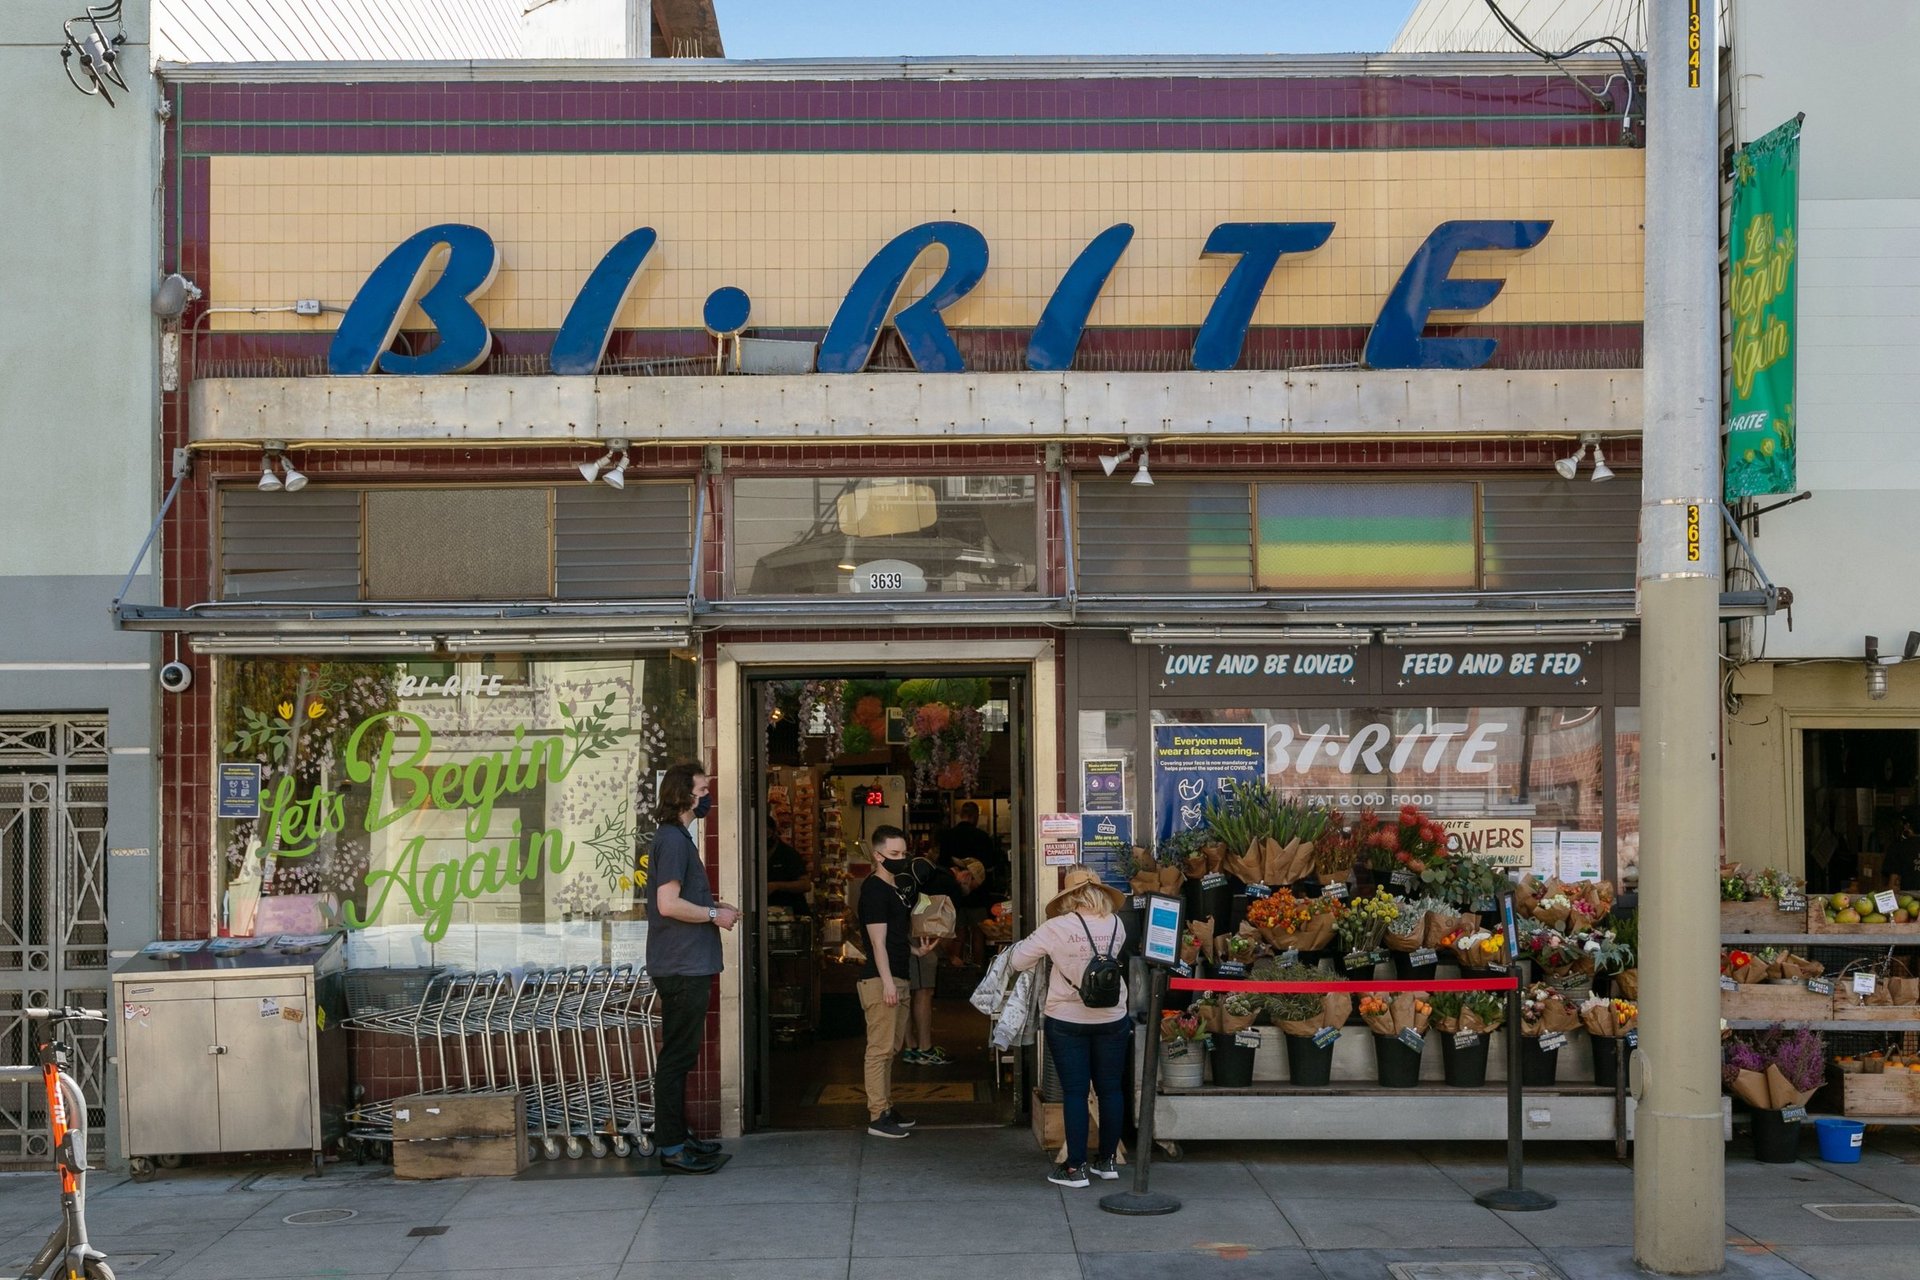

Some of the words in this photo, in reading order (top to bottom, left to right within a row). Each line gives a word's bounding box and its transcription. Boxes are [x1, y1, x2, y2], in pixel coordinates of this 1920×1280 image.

[1688, 506, 1699, 561] 365
[871, 573, 901, 589] 3639
[1165, 654, 1213, 675] LOVE
[1216, 654, 1259, 675] AND
[1263, 654, 1290, 675] BE
[1293, 654, 1354, 675] LOVED
[1402, 653, 1453, 675] FEED
[1458, 653, 1504, 675] AND
[1508, 653, 1537, 675] BE
[1540, 653, 1581, 675] FED
[1174, 737, 1218, 747] Everyone
[1219, 737, 1242, 745] must
[1191, 747, 1211, 755] face
[1212, 747, 1259, 757] covering...
[346, 711, 573, 842] Begin
[867, 792, 882, 804] 23
[1307, 794, 1334, 806] EAT
[1339, 794, 1385, 806] GOOD
[1391, 794, 1433, 806] FOOD
[1446, 828, 1523, 853] OWERS
[344, 819, 575, 943] Again
